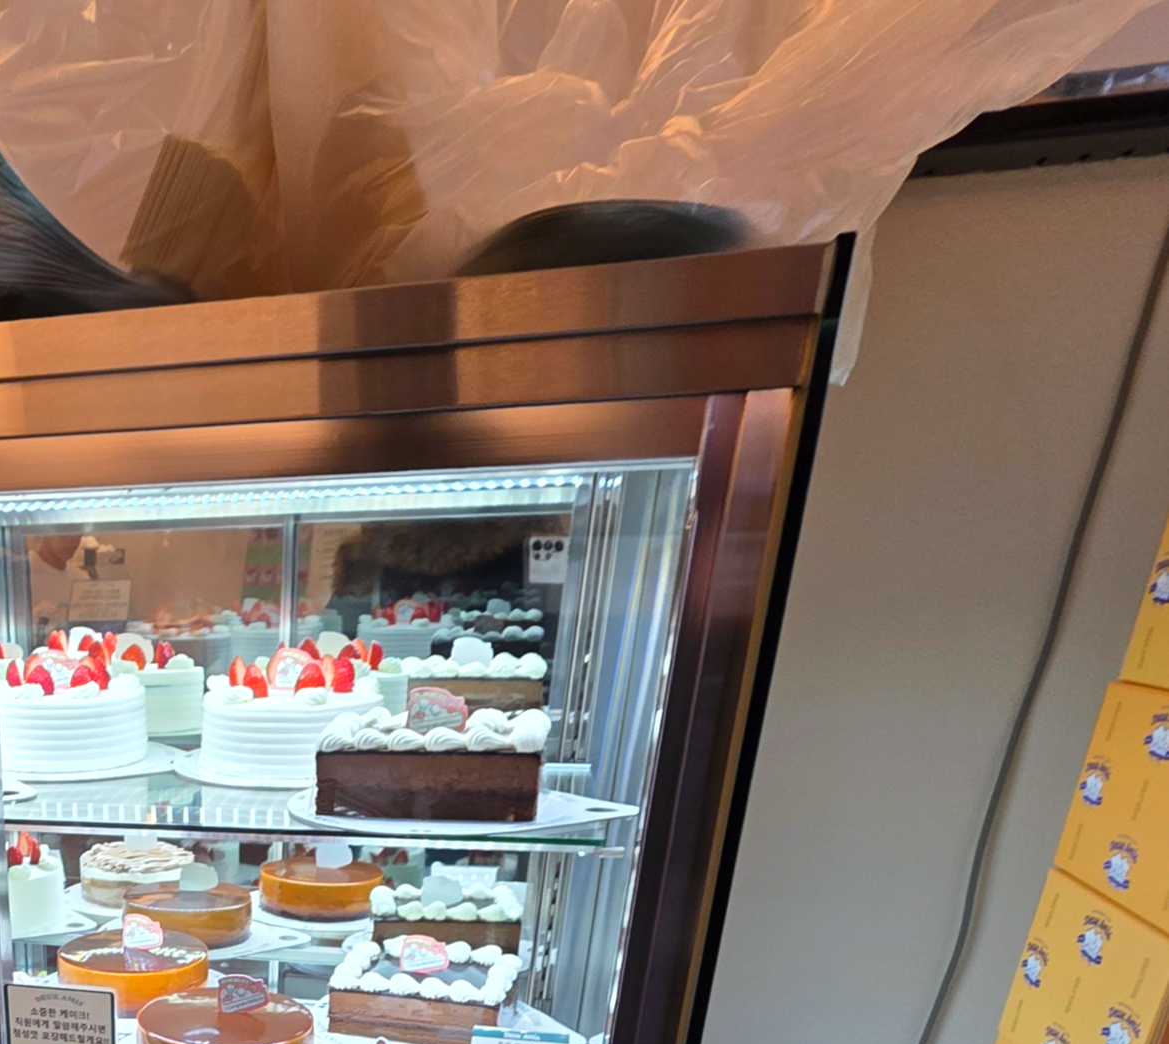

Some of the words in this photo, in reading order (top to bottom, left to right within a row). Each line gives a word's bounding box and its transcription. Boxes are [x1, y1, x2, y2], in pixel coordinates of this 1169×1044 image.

[60, 994, 85, 1007] AMIS
[30, 1006, 57, 1018] 소중한
[59, 1008, 90, 1021] 케이크!
[14, 1016, 50, 1029] 직원에게
[52, 1020, 106, 1035] 말씀해주시면
[12, 1028, 39, 1040] 정성껏
